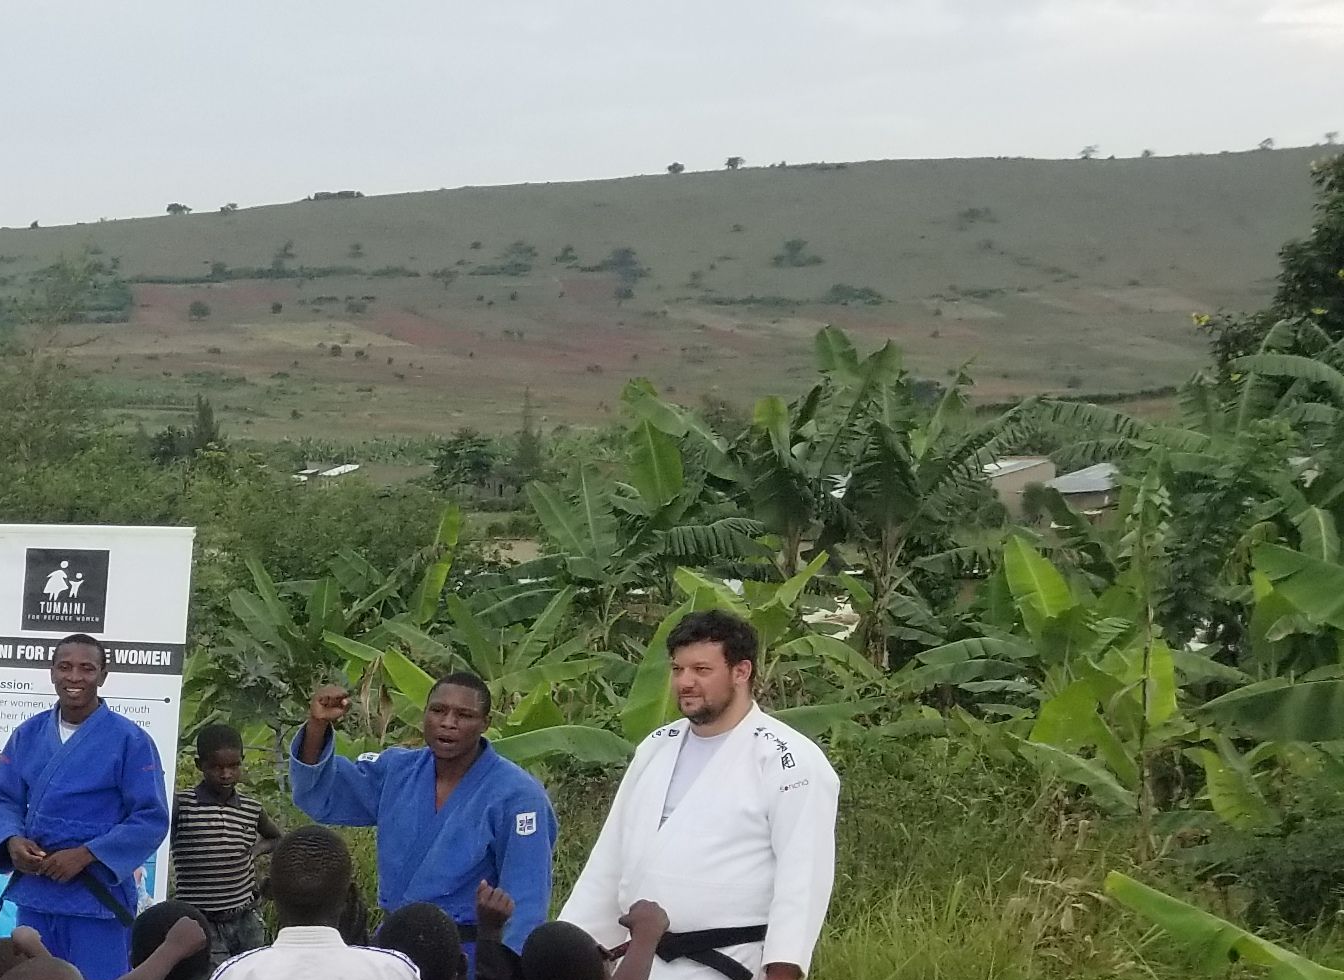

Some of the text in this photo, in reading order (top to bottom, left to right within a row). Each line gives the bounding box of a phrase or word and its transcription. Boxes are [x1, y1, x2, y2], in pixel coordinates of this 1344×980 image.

[39, 602, 86, 614] TUMAINI
[16, 645, 45, 660] FOR
[114, 649, 172, 666] WOMEN
[10, 700, 46, 709] women,
[108, 704, 150, 714] nd youth
